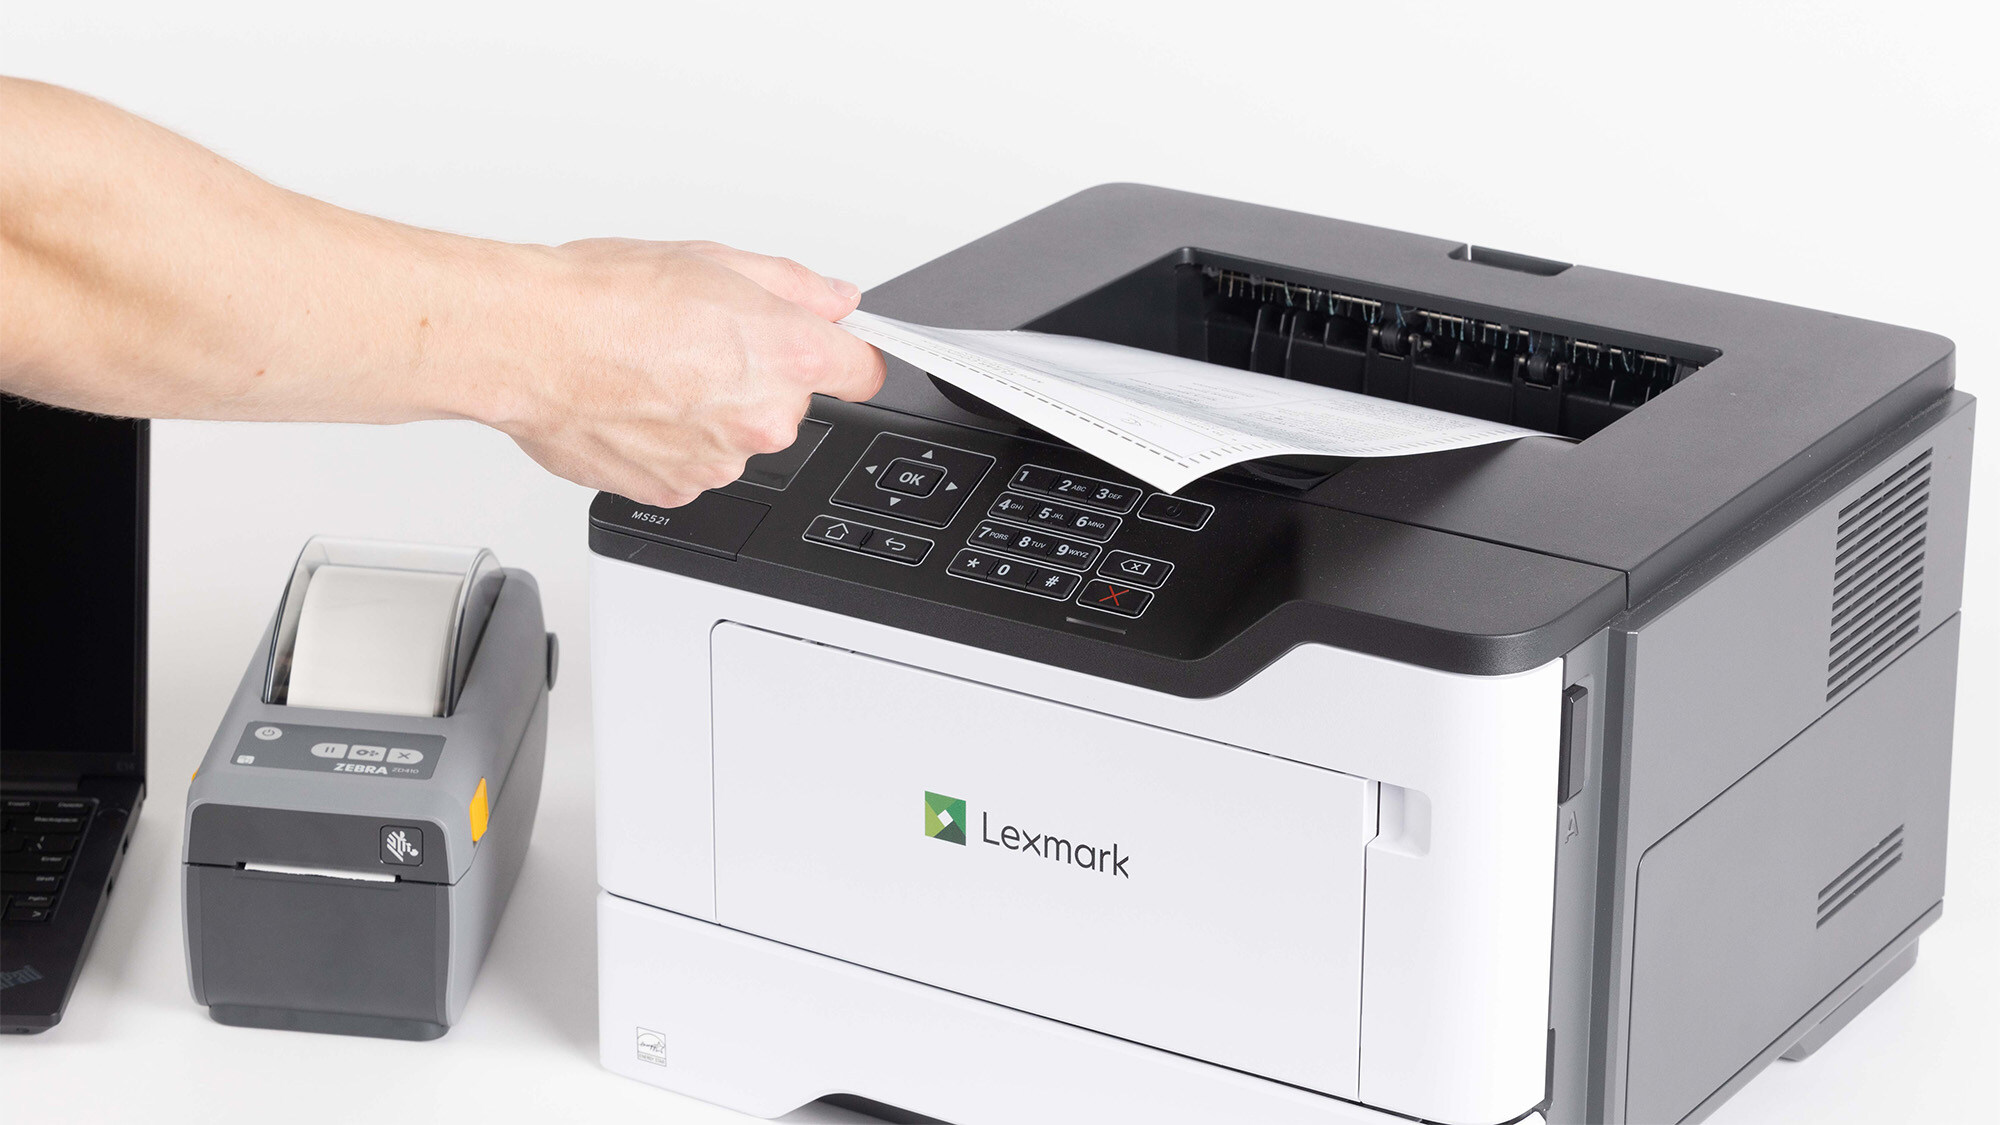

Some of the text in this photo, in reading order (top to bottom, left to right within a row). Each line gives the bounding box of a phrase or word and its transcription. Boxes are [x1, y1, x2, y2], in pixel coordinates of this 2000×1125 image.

[899, 471, 923, 487] OK
[1019, 470, 1122, 501] 1 2 ABC 3 DEF
[631, 510, 670, 526] MS521
[998, 498, 1105, 530] 4 GHI 5 JKL 6 MNO
[978, 526, 1089, 559] 7 PQRS 8 TUV 9 WXYZ
[997, 564, 1010, 576] 0
[1045, 575, 1059, 587] #
[333, 762, 419, 775] ZEBRA ZD410
[983, 811, 1130, 879] Lexmark
